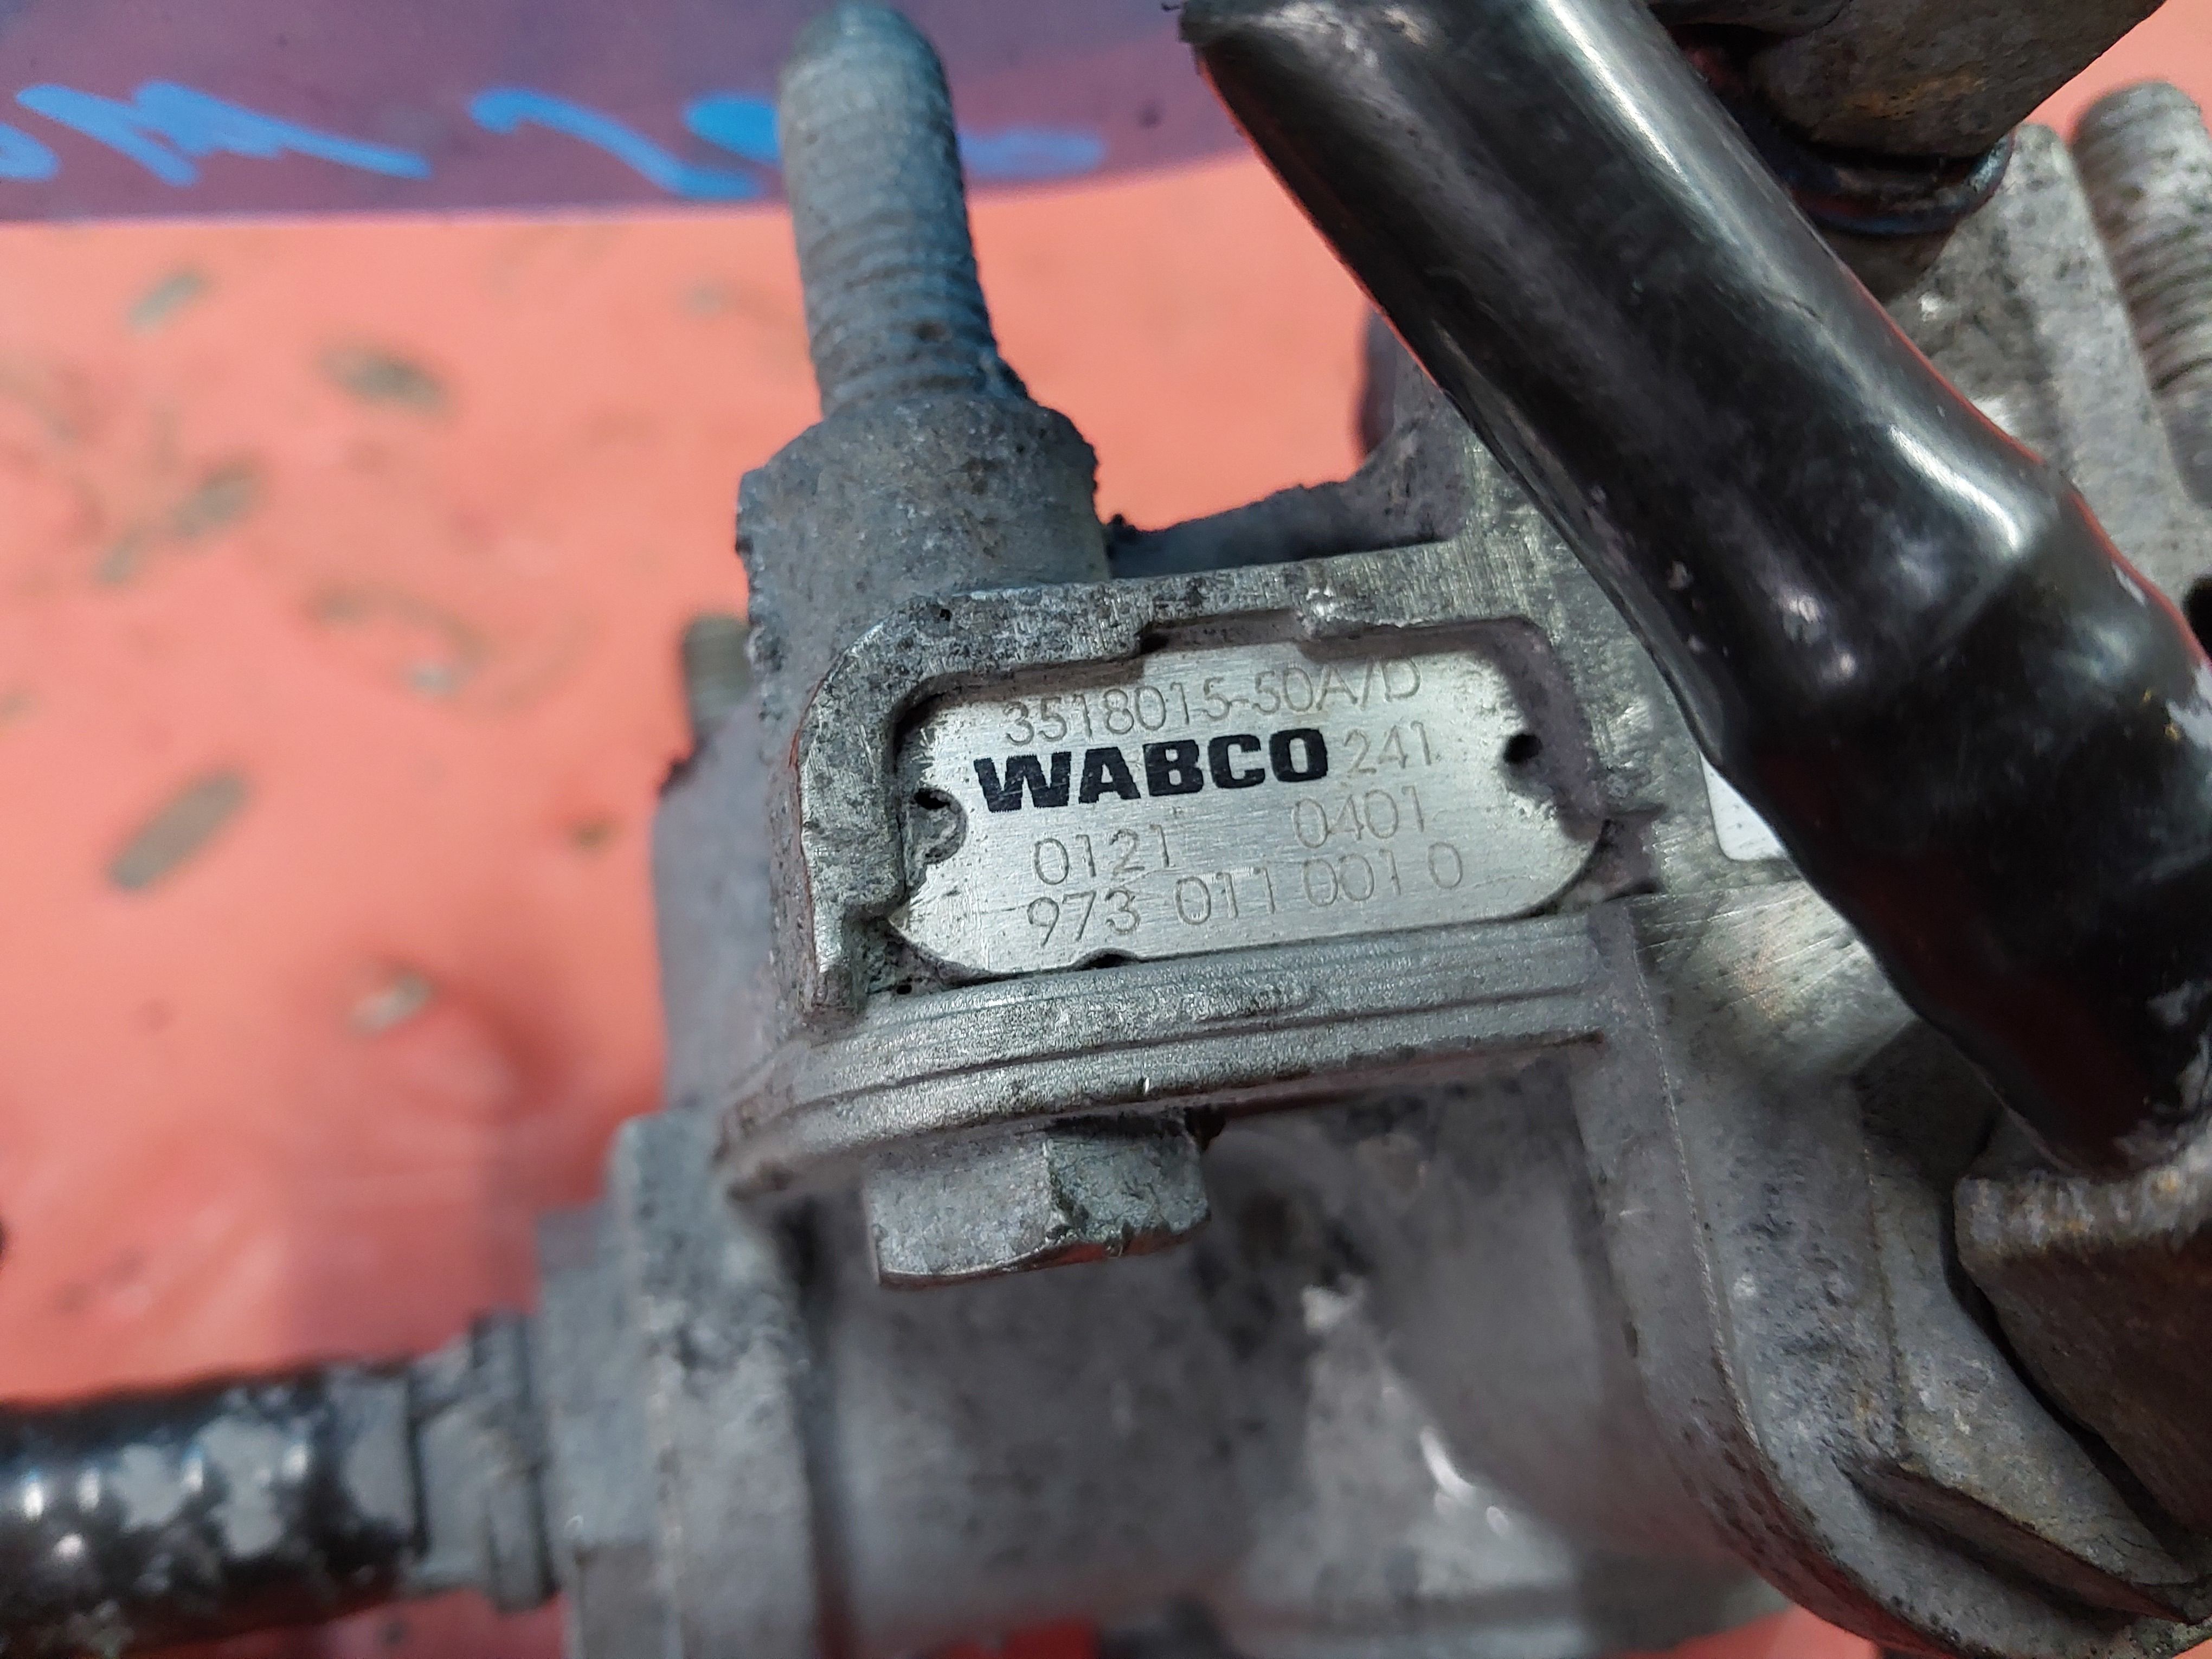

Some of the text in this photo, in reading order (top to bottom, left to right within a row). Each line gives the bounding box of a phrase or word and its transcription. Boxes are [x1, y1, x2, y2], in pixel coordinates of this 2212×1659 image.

[1002, 654, 1422, 746] 3518015-50A/D
[974, 720, 1432, 813] WABCO 241
[1033, 786, 1425, 885] 0121 0401
[1027, 885, 1140, 948] 973
[1175, 867, 1276, 925] 011
